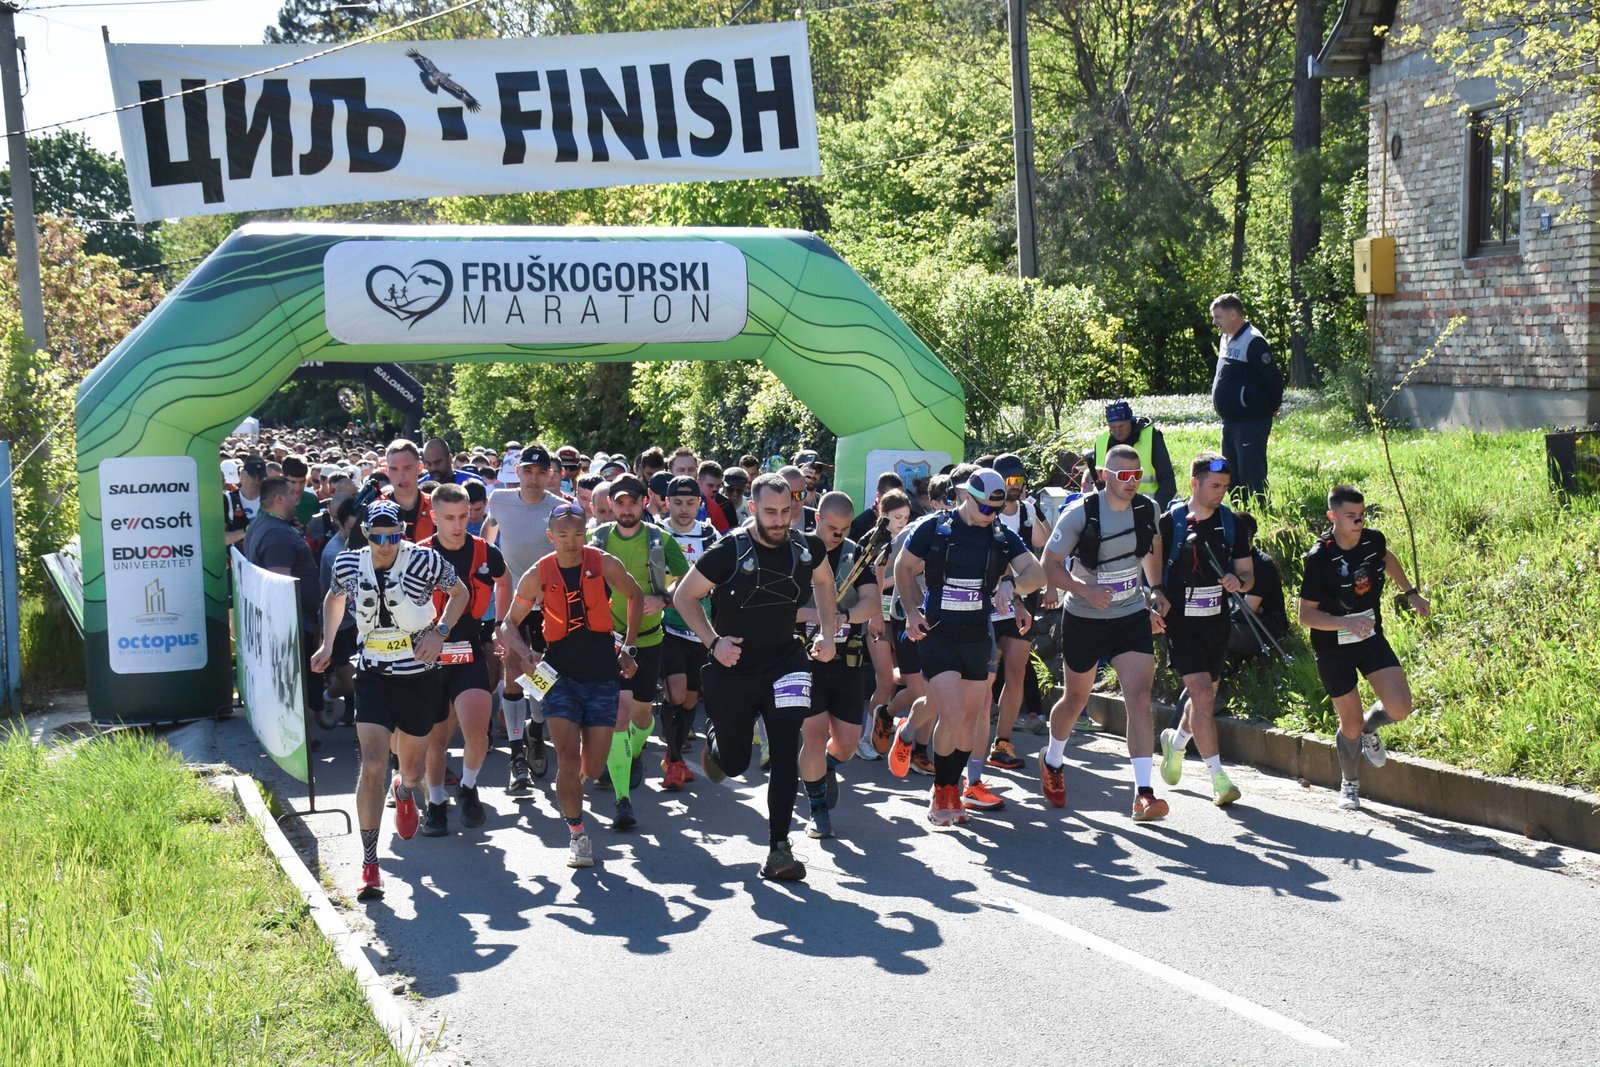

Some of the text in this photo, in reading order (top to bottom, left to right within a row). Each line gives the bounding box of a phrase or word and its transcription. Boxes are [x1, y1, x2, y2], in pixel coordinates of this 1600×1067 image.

[138, 77, 407, 204] ЦИЉ
[495, 55, 799, 166] FINISH
[462, 254, 709, 292] FRUŠKOGORSKI
[463, 294, 710, 325] MARATON
[374, 366, 417, 403] SALOMON
[108, 482, 190, 495] SALOMON
[113, 559, 192, 571] UNIVERZITET
[1122, 579, 1133, 590] 15
[967, 591, 979, 601] 12
[1208, 597, 1218, 607] 21
[117, 633, 199, 653] octopus
[387, 639, 408, 651] 424
[451, 653, 471, 664] 271
[531, 673, 548, 691] 425
